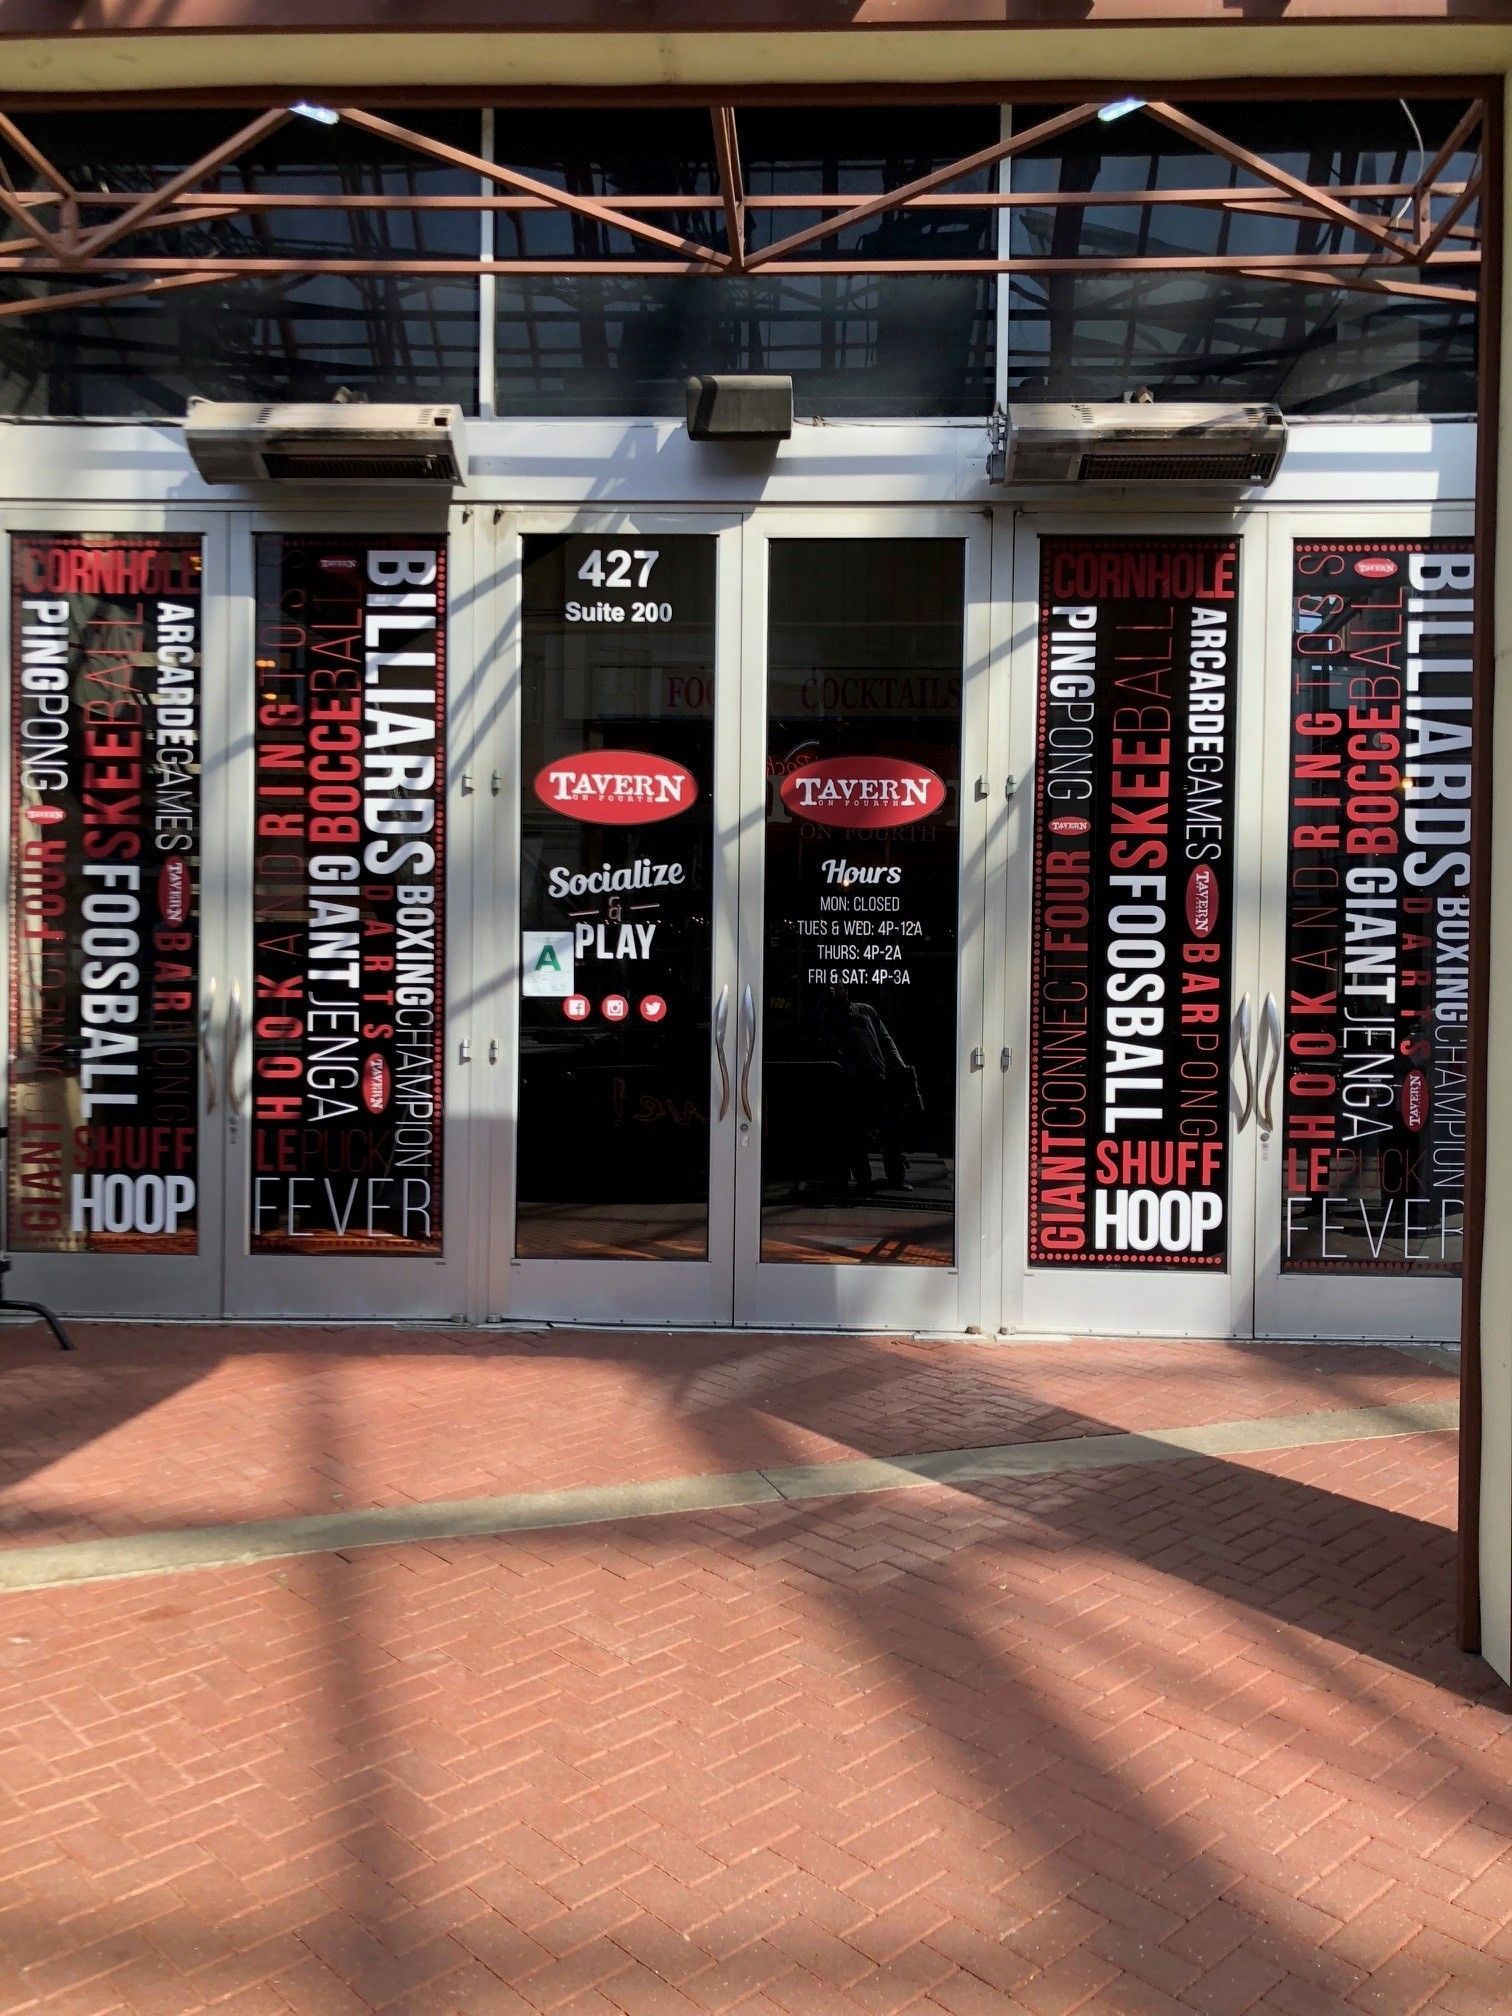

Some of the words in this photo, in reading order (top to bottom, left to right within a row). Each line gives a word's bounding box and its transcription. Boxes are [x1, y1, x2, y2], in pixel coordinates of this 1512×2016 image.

[24, 549, 201, 594] CORNHOLE
[577, 550, 660, 588] 427
[1052, 552, 1236, 599] CORNHOLE
[564, 602, 625, 622] Suite
[631, 603, 673, 622] 200
[21, 600, 70, 791] PINGPONG
[308, 577, 362, 842] BOCCEBALL
[363, 550, 437, 876] BILLIARDS
[801, 678, 962, 709] COCKTAILS
[1047, 606, 1097, 800] PINGPONG
[83, 602, 144, 860] SKEEBALL
[1109, 606, 1174, 869] SKEEBALL
[1346, 585, 1403, 854] BOCCEBALL
[1403, 553, 1475, 887] BILLIARDS
[549, 772, 686, 802] TAVERN
[796, 778, 931, 806] TAVERN
[818, 799, 835, 807] ON
[1052, 821, 1088, 831] TAVERN
[548, 858, 686, 898] Socialize
[821, 859, 901, 884] Hours
[820, 896, 850, 911] MON:
[853, 896, 900, 911] CLOSED
[1195, 871, 1209, 931] TAVERN
[574, 923, 656, 959] PLAY
[797, 920, 827, 935] TUES
[832, 920, 839, 935] &
[843, 920, 874, 935] WED:
[878, 920, 923, 935] 4P-12A
[363, 884, 394, 1039] DARTS
[534, 945, 562, 971] A
[817, 945, 860, 960] THURS:
[863, 945, 902, 960] 4P-2A
[80, 865, 140, 1119] FOOSBALL
[808, 969, 826, 984] FRI
[830, 969, 838, 984] &
[841, 969, 868, 984] SAT:
[872, 969, 911, 984] 4P-3A
[1400, 897, 1432, 1058] DARTS
[1105, 875, 1167, 1133] FOOSBALL
[1410, 1074, 1421, 1126] TAVERN
[72, 1126, 195, 1170] SHUFF
[1096, 1140, 1223, 1186] SHUFF
[70, 1173, 196, 1234] HOOP
[254, 1177, 431, 1237] FEVER
[1095, 1189, 1223, 1252] HOOP
[1286, 1198, 1464, 1259] FEVER
